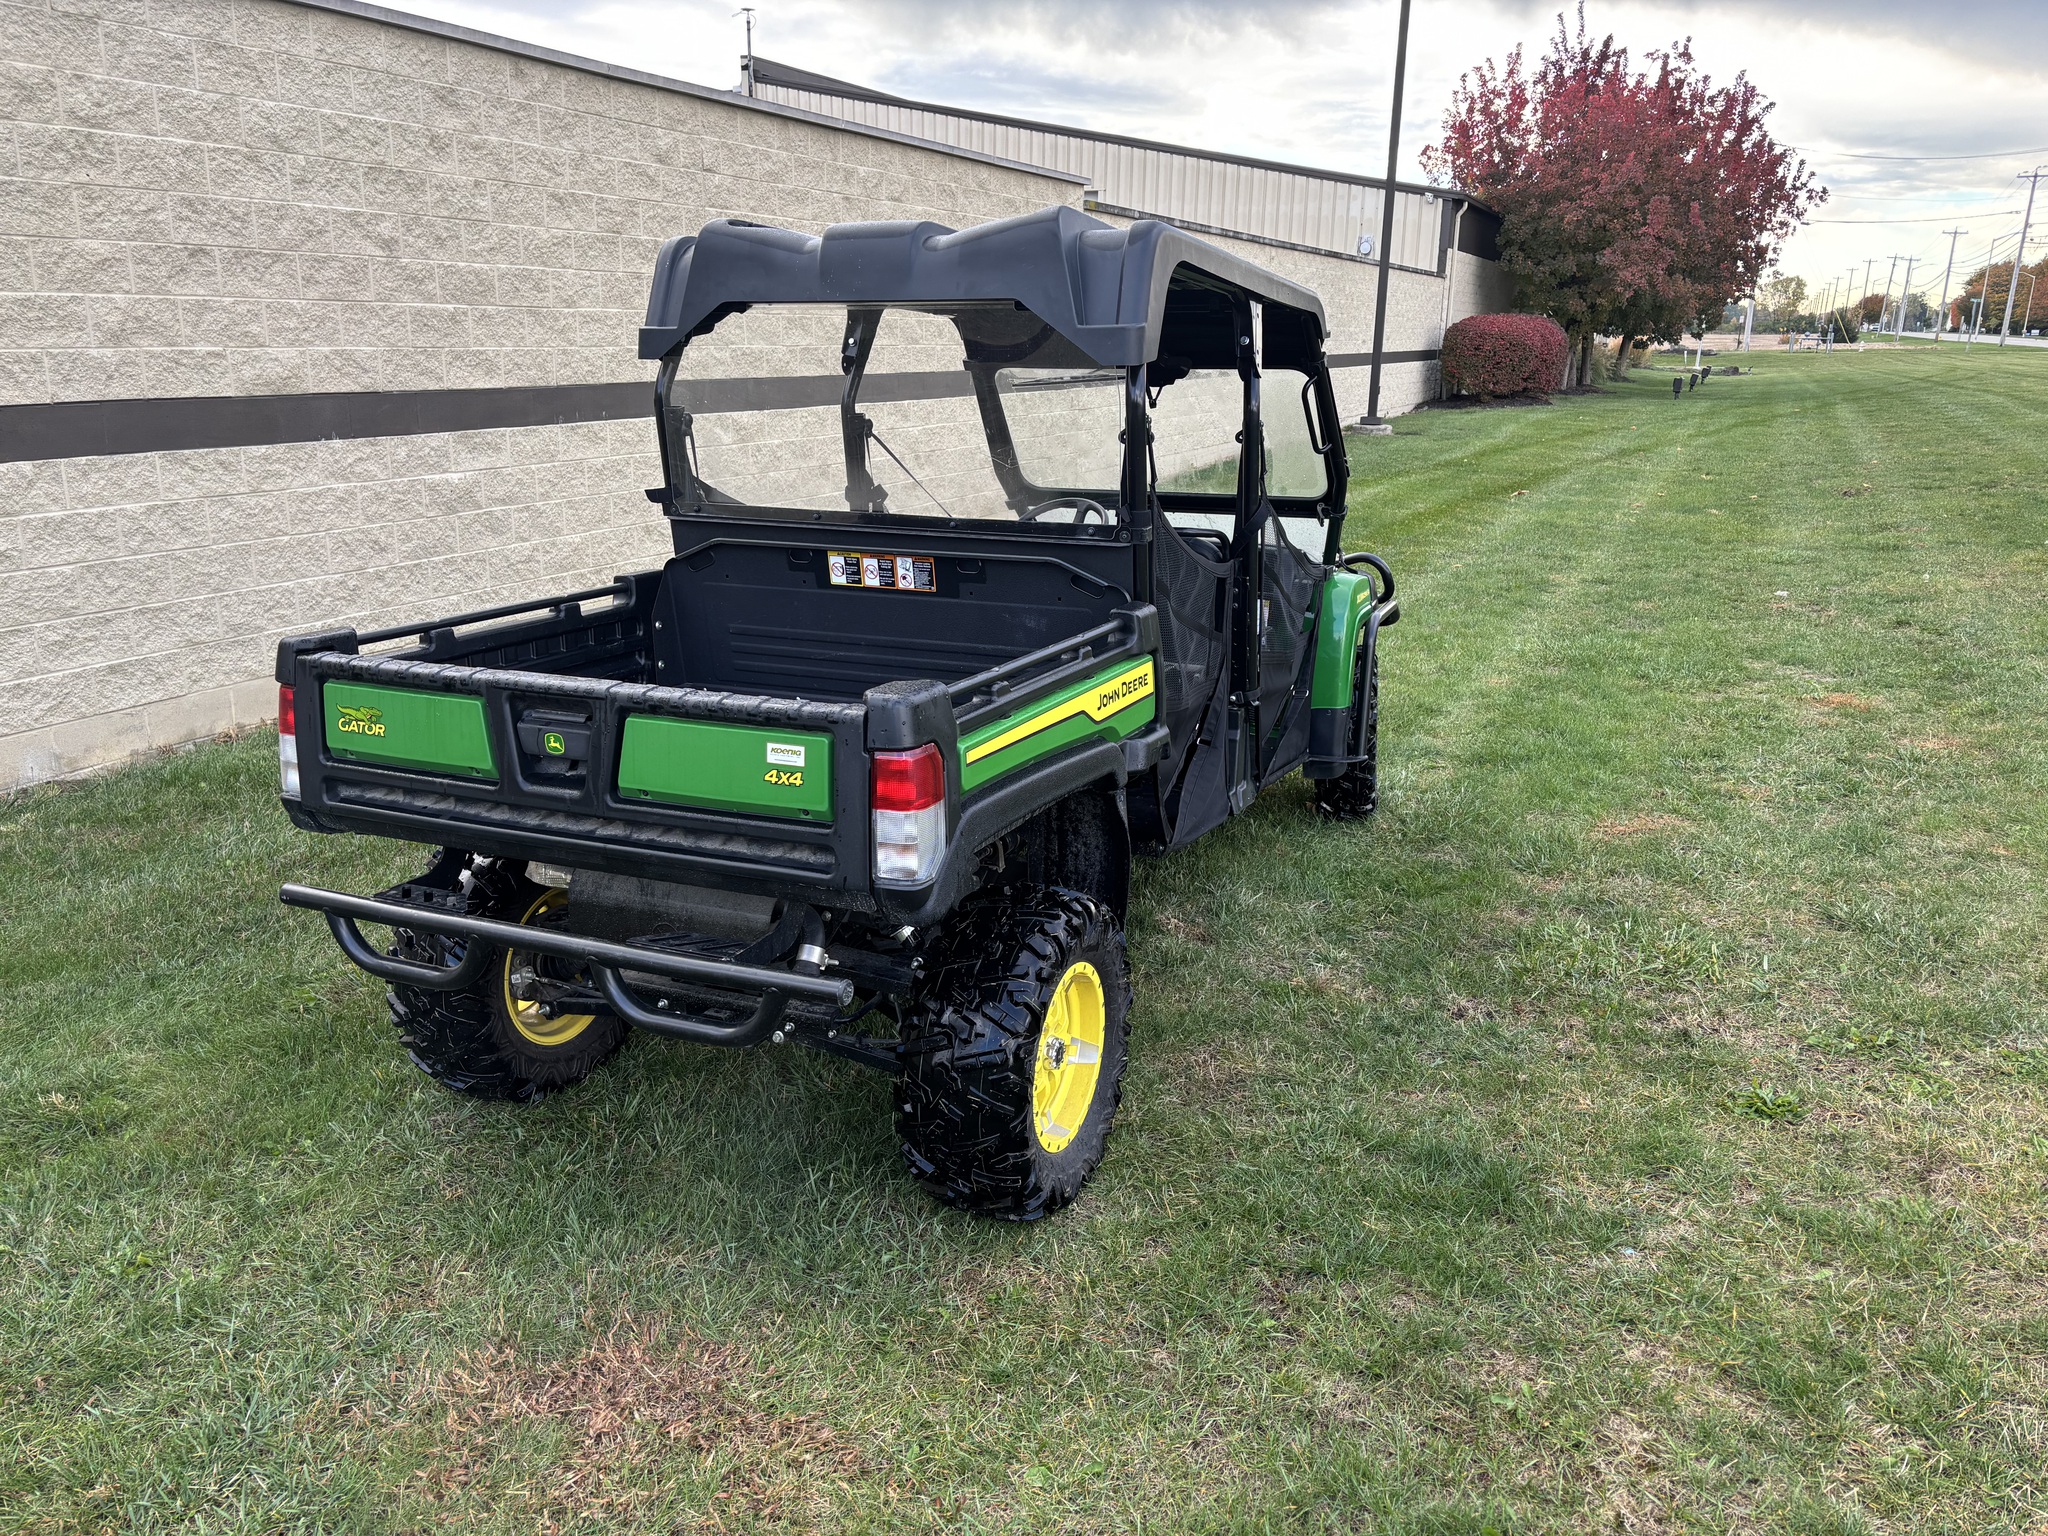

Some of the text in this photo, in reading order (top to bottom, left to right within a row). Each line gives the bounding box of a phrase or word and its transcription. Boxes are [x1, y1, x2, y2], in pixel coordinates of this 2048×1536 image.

[1097, 673, 1148, 711] JOHN DEERE
[338, 717, 386, 737] GATOR
